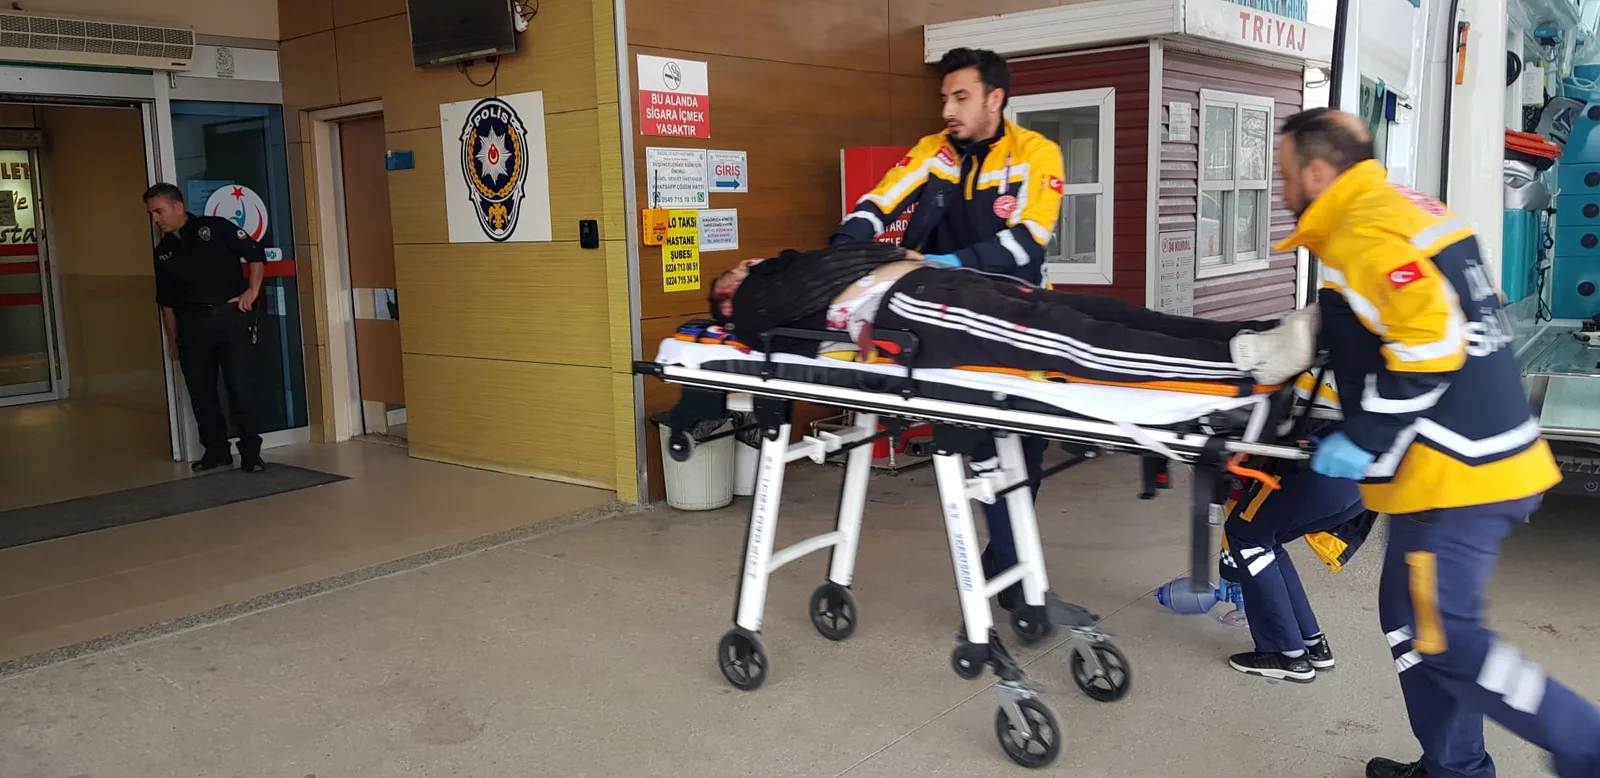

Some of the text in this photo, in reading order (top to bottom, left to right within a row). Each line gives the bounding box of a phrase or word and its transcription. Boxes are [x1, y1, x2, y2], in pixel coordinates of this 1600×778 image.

[651, 93, 698, 107] BU ALANDA
[474, 107, 508, 126] POLİS
[646, 106, 704, 123] SİGARA İÇMEK
[656, 124, 696, 135] YASAKTIR
[0, 162, 29, 179] LET
[715, 162, 741, 178] GİRİŞ
[668, 217, 676, 228] LO
[666, 236, 695, 246] HASTANE
[665, 264, 676, 272] 0224
[677, 263, 686, 271] 713
[666, 276, 677, 285] 0224
[677, 276, 686, 284] 715
